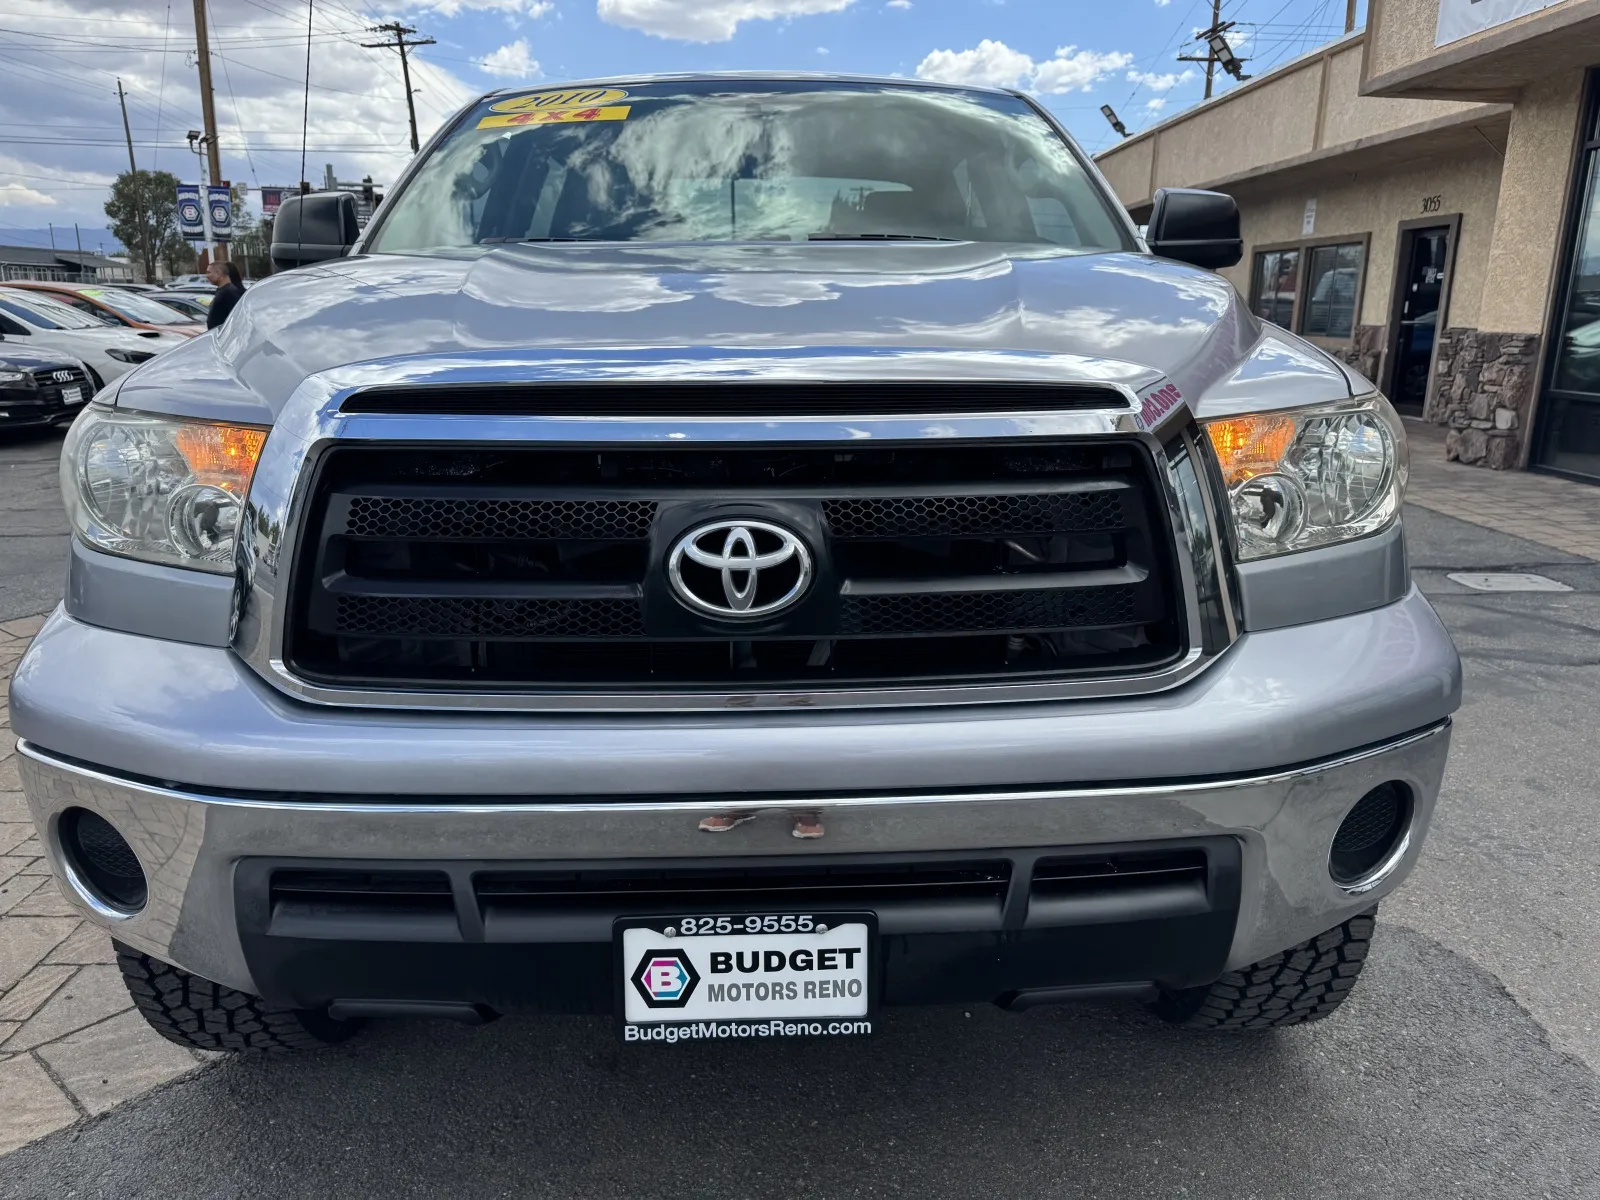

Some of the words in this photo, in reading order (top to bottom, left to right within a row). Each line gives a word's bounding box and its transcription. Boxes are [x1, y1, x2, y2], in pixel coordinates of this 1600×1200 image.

[510, 90, 607, 110] 2010
[1420, 194, 1442, 214] 3055
[680, 915, 814, 935] 825-9555
[709, 947, 862, 974] BUDGET
[707, 981, 798, 1002] MOTORS
[803, 979, 862, 999] RENO
[624, 1020, 873, 1043] BudgetMotorsReno.com
